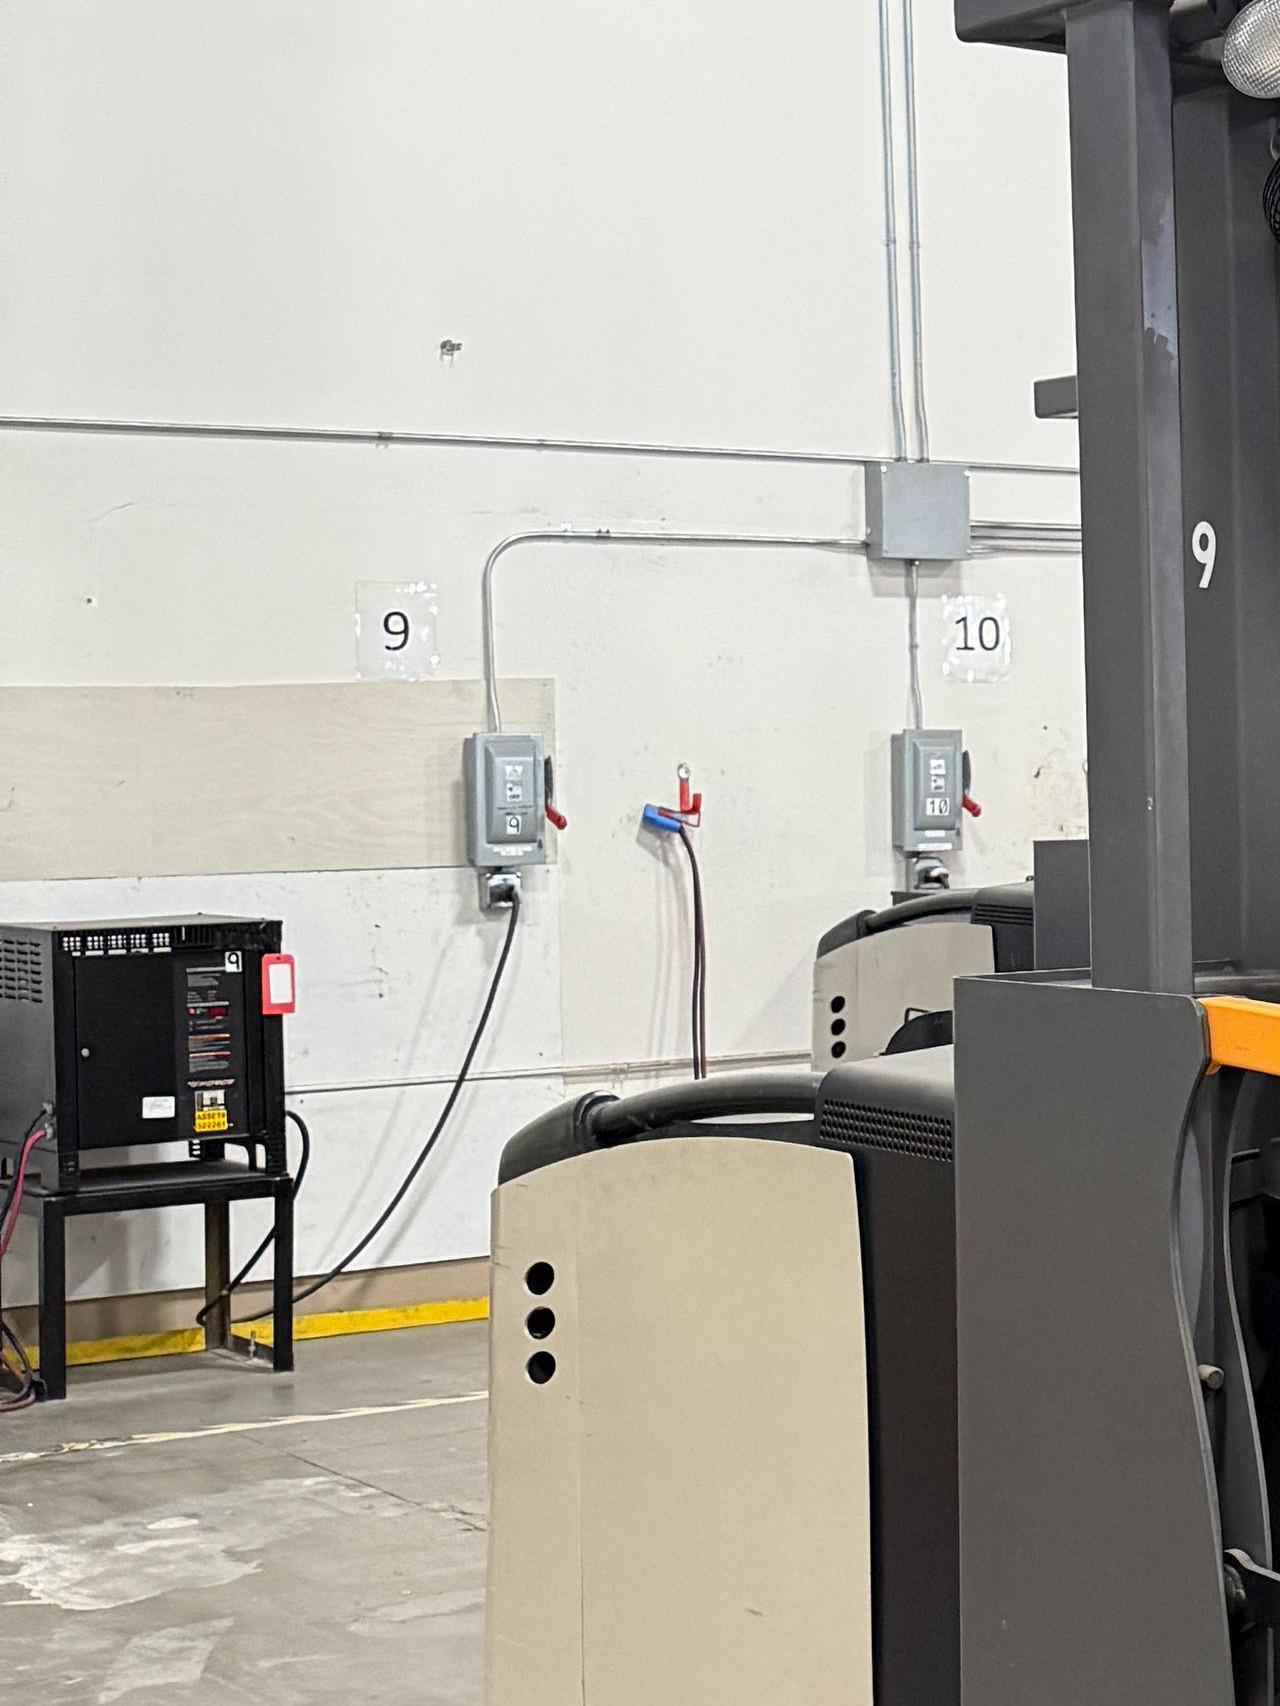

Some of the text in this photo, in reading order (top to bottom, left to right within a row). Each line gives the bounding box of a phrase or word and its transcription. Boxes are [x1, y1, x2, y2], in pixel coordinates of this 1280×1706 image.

[1191, 520, 1216, 589] 9
[383, 611, 410, 651] 9
[955, 616, 1000, 651] 10
[929, 799, 949, 814] 10
